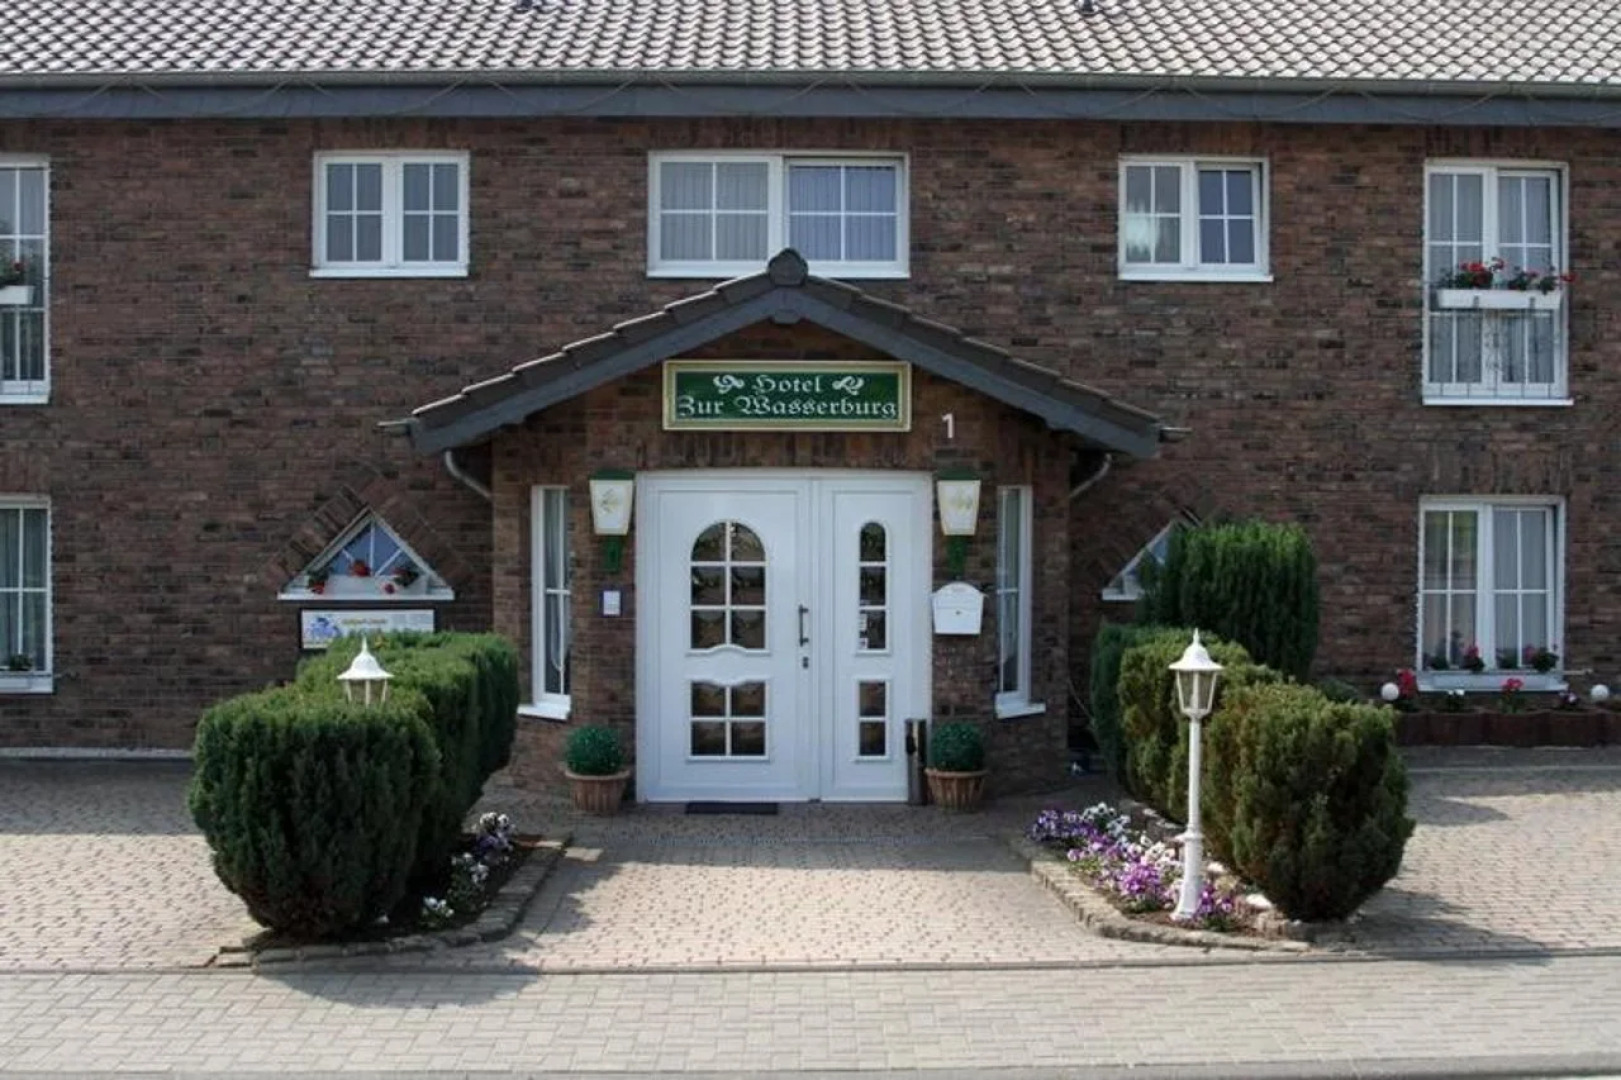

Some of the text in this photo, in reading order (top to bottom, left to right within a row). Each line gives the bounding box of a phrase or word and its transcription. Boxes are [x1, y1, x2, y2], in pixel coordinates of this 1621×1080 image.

[752, 374, 823, 396] Hotel
[678, 394, 898, 419] Zur Wasserburg
[941, 413, 955, 439] 1
